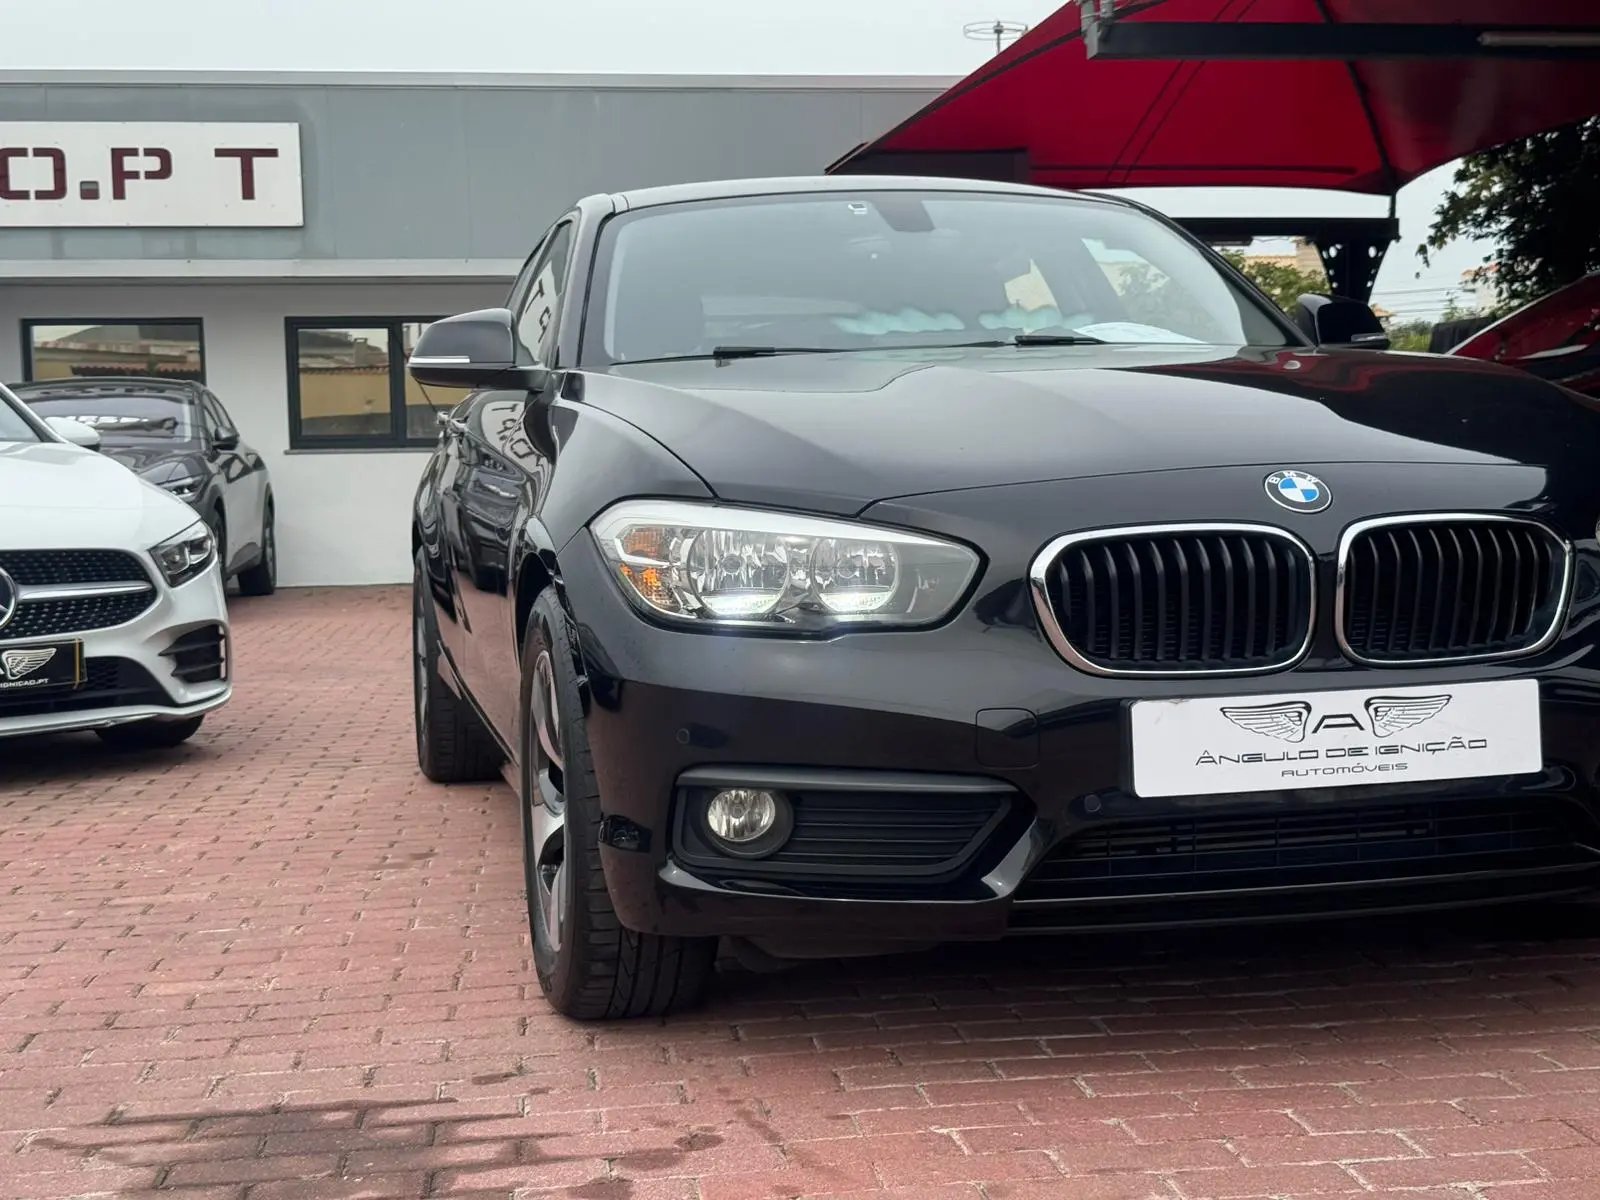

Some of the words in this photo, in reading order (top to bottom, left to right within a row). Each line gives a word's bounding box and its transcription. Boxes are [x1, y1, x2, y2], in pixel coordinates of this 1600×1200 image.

[1268, 471, 1320, 484] BMW
[1195, 750, 1319, 766] ÂNGULO
[1325, 746, 1369, 758] DE
[1375, 737, 1487, 755] IGNIÇÃO
[1281, 762, 1408, 777] AUTOMÓVEIS
